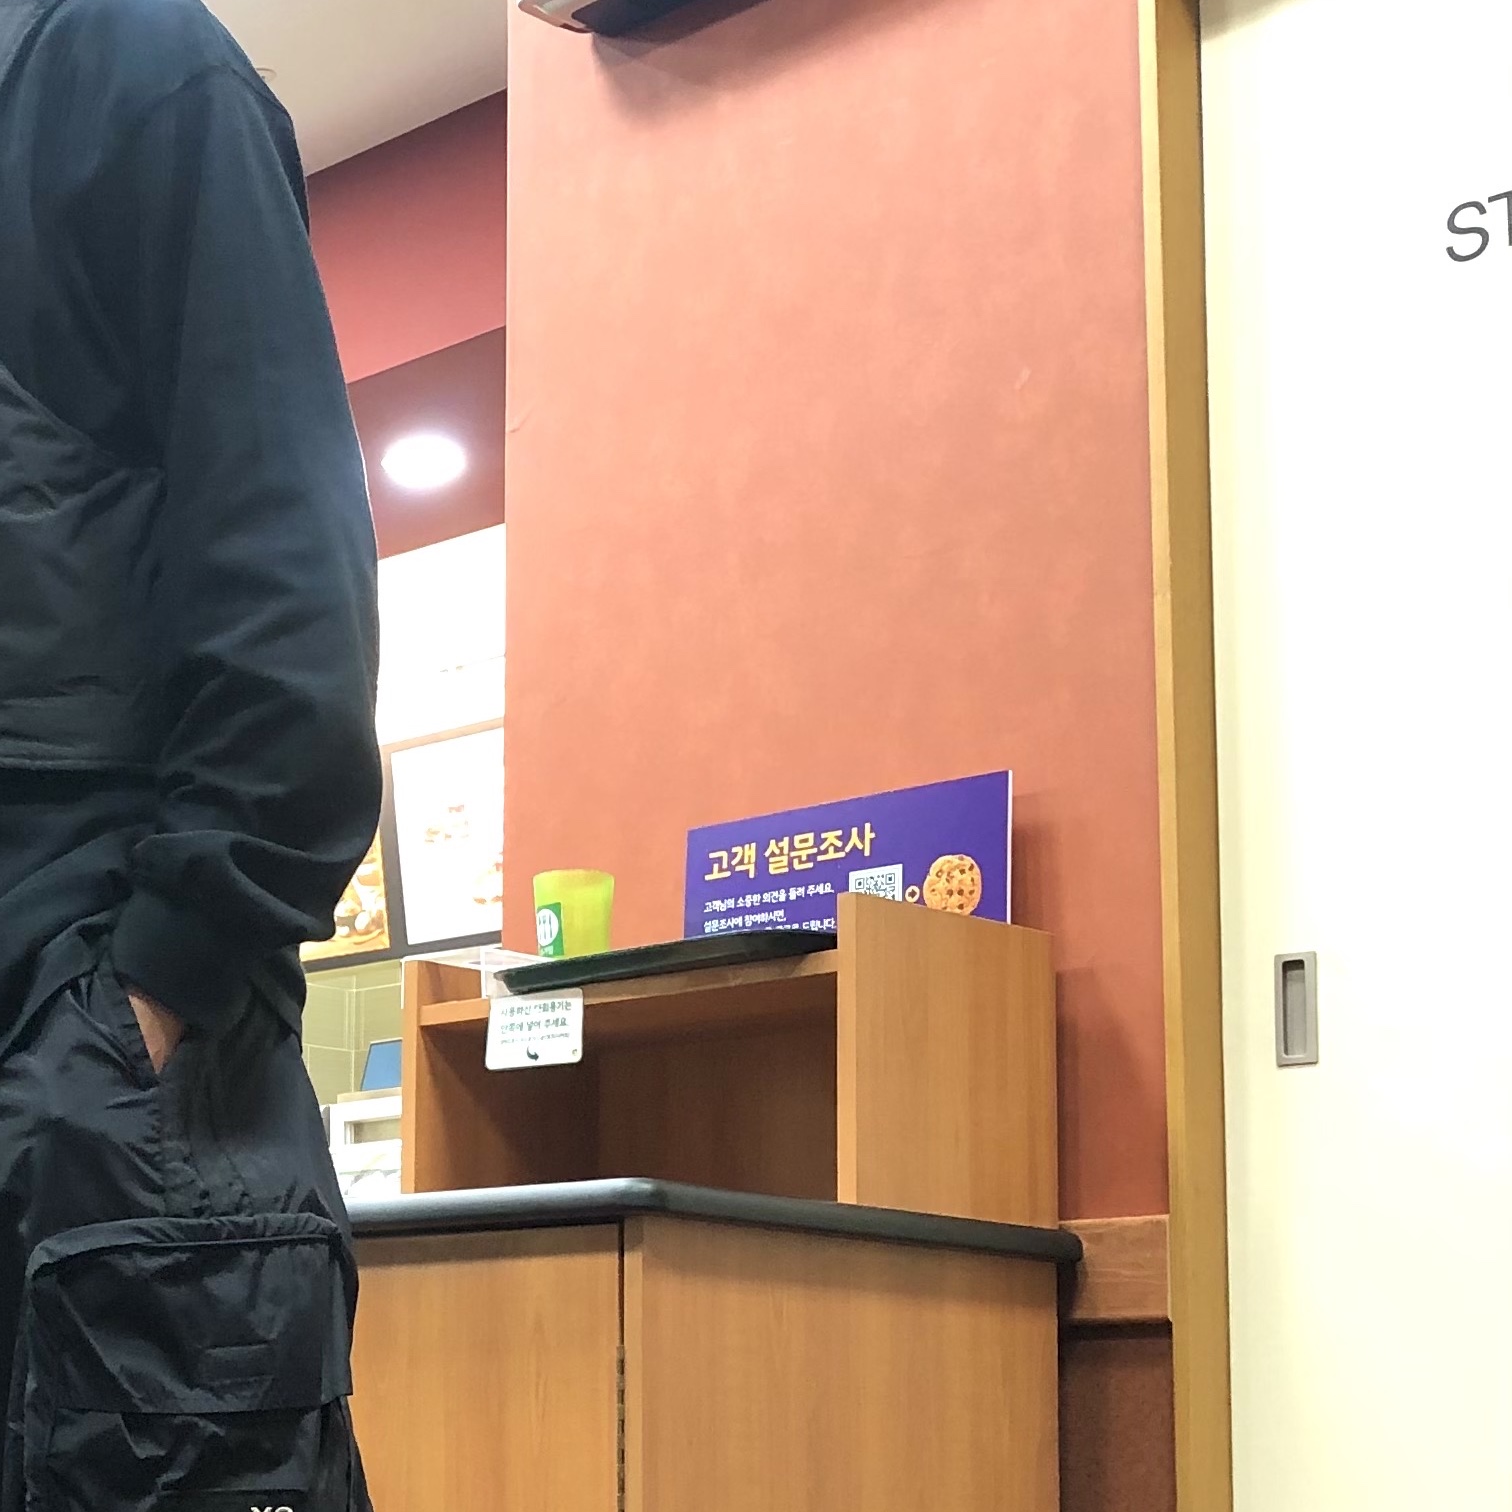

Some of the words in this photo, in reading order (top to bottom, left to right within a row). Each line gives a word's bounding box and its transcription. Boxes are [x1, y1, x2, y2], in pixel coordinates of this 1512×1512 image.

[704, 842, 757, 881] 고객
[764, 822, 876, 875] 설문조사
[703, 898, 735, 913] 고객님의
[736, 893, 761, 908] 소중한
[762, 888, 787, 903] 의견을
[703, 915, 742, 933] 설문조사에
